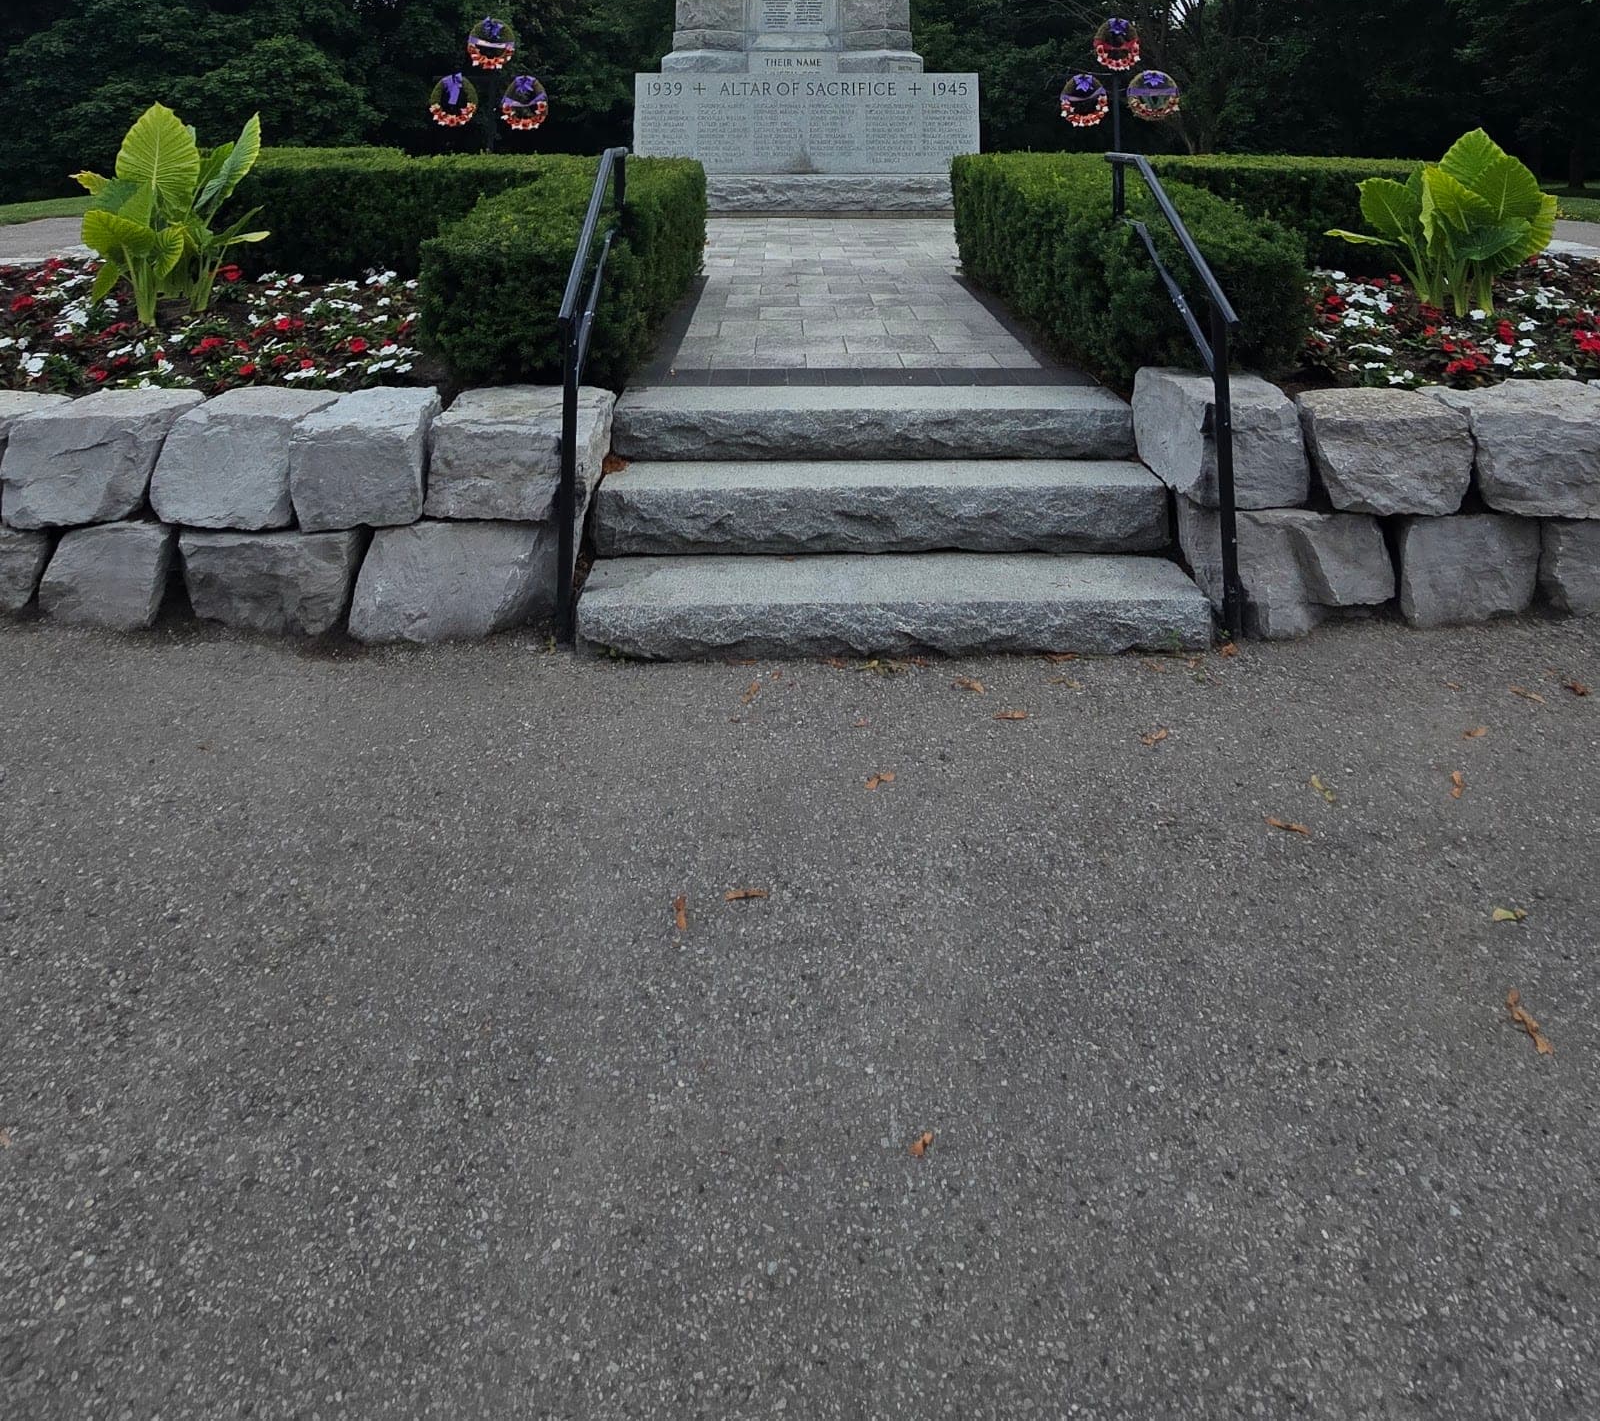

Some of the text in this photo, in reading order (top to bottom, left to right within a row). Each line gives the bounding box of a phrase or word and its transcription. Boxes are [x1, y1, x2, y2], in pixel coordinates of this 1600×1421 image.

[764, 58, 822, 67] THEIR NAME
[647, 82, 968, 96] 1939 ALTAR OF SACRIFICE 1945
